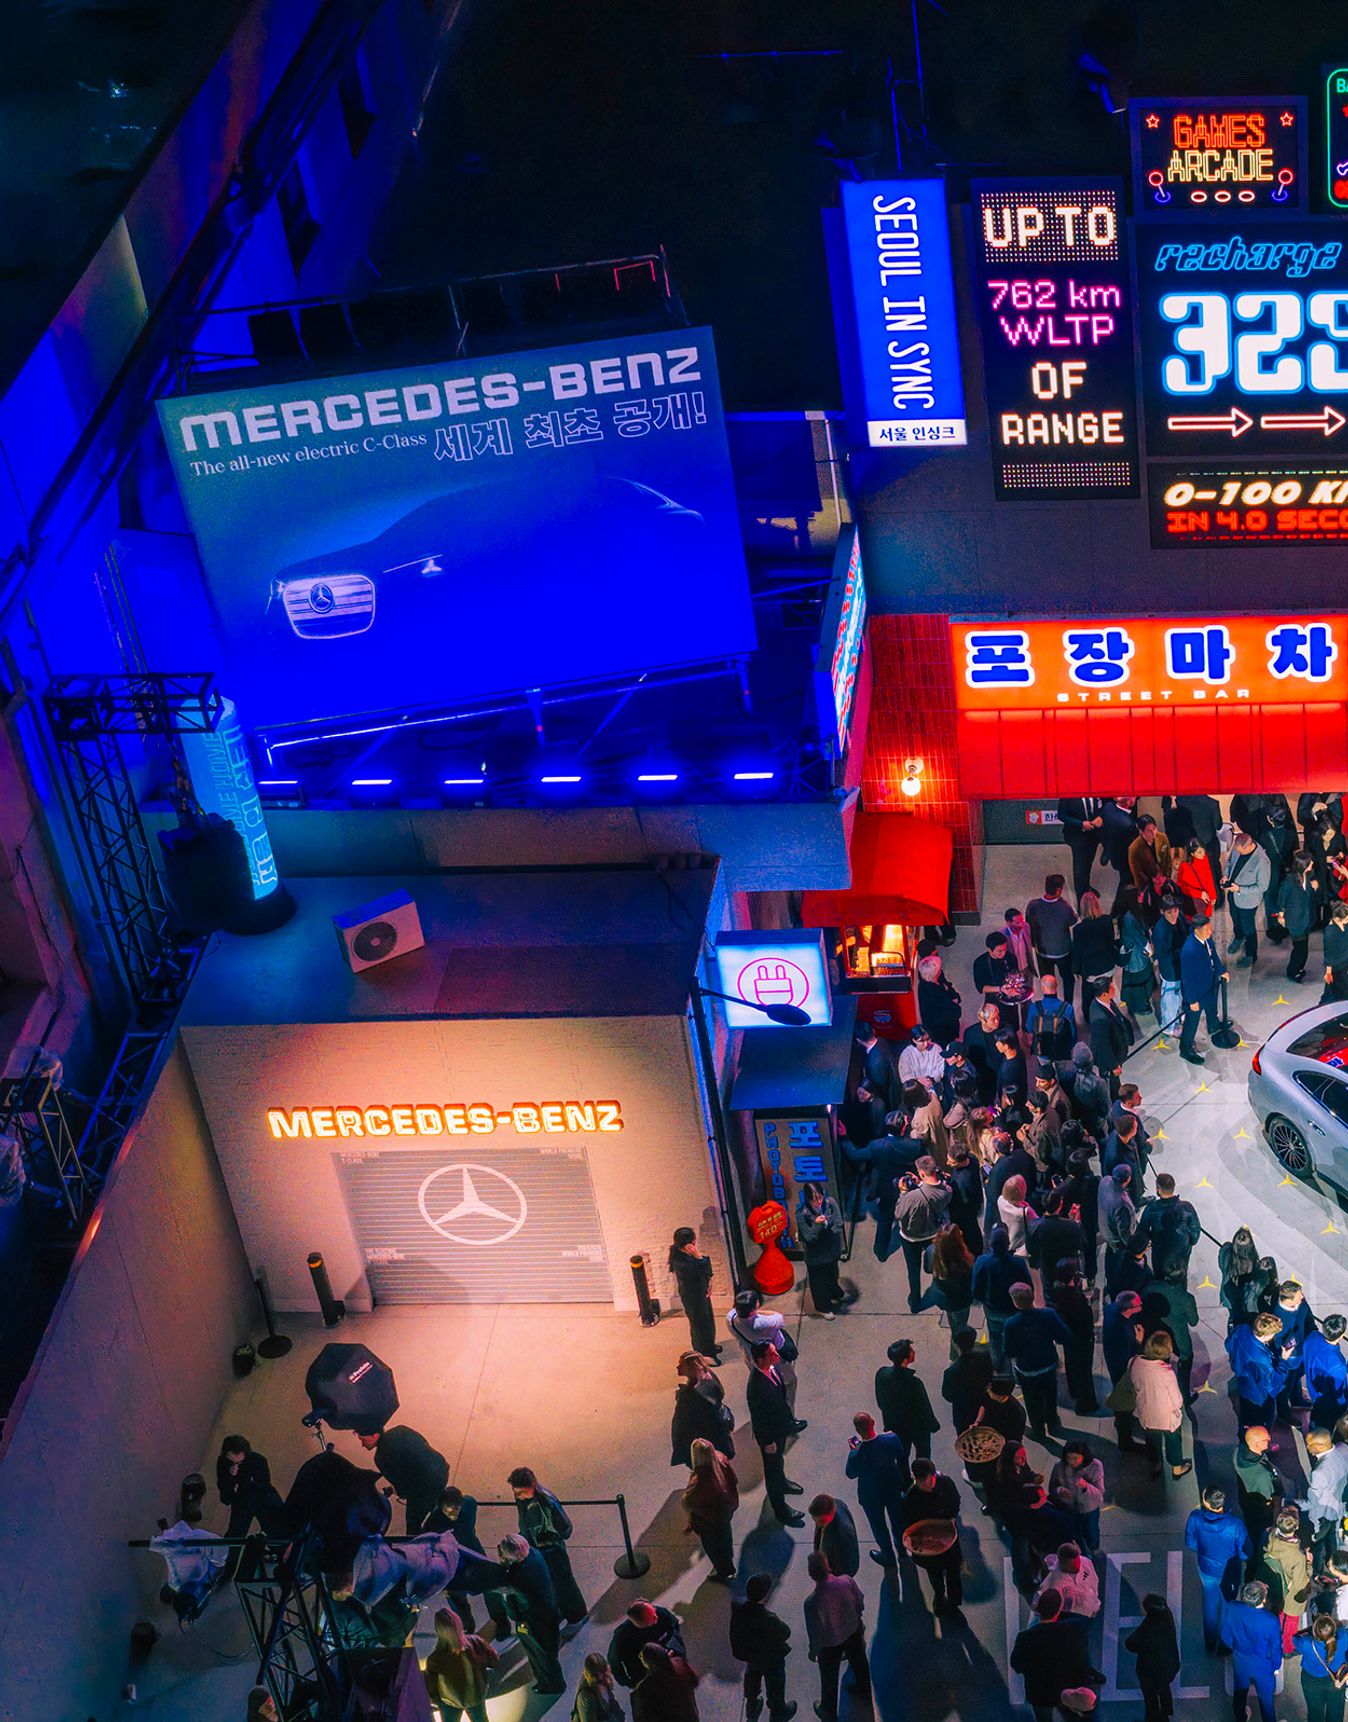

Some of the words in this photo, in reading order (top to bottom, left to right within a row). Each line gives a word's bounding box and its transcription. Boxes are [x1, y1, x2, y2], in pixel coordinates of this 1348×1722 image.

[1174, 114, 1265, 148] GAMES
[1167, 149, 1273, 182] ARCADE
[873, 195, 922, 287] SEOUL
[984, 207, 1044, 248] UP
[1055, 206, 1117, 247] TO
[1155, 236, 1342, 277] recharge
[988, 281, 1056, 310] 762
[1069, 279, 1121, 308] km
[883, 296, 928, 332] IN
[999, 314, 1115, 346] WLTP
[888, 341, 935, 410] SYNC
[1032, 362, 1087, 399] OF
[178, 346, 702, 453] MERCEDES-BENZ
[433, 418, 514, 462] 세계
[524, 408, 604, 450] 최초
[613, 391, 708, 439] 공개!
[879, 426, 908, 442] 서울
[912, 425, 956, 441] 인싱크
[1001, 412, 1124, 445] RANGE
[190, 460, 226, 478] The
[229, 451, 292, 472] all-new
[294, 442, 360, 464] electric
[363, 433, 428, 453] C-Class
[1164, 480, 1301, 507] 0-100
[1166, 511, 1209, 533] IN
[1216, 510, 1269, 532] 4.0
[1056, 690, 1173, 703] STREET
[1193, 687, 1252, 699] BAR
[266, 1100, 624, 1140] MERCEDES-BENZ
[788, 1122, 829, 1209] 포토
